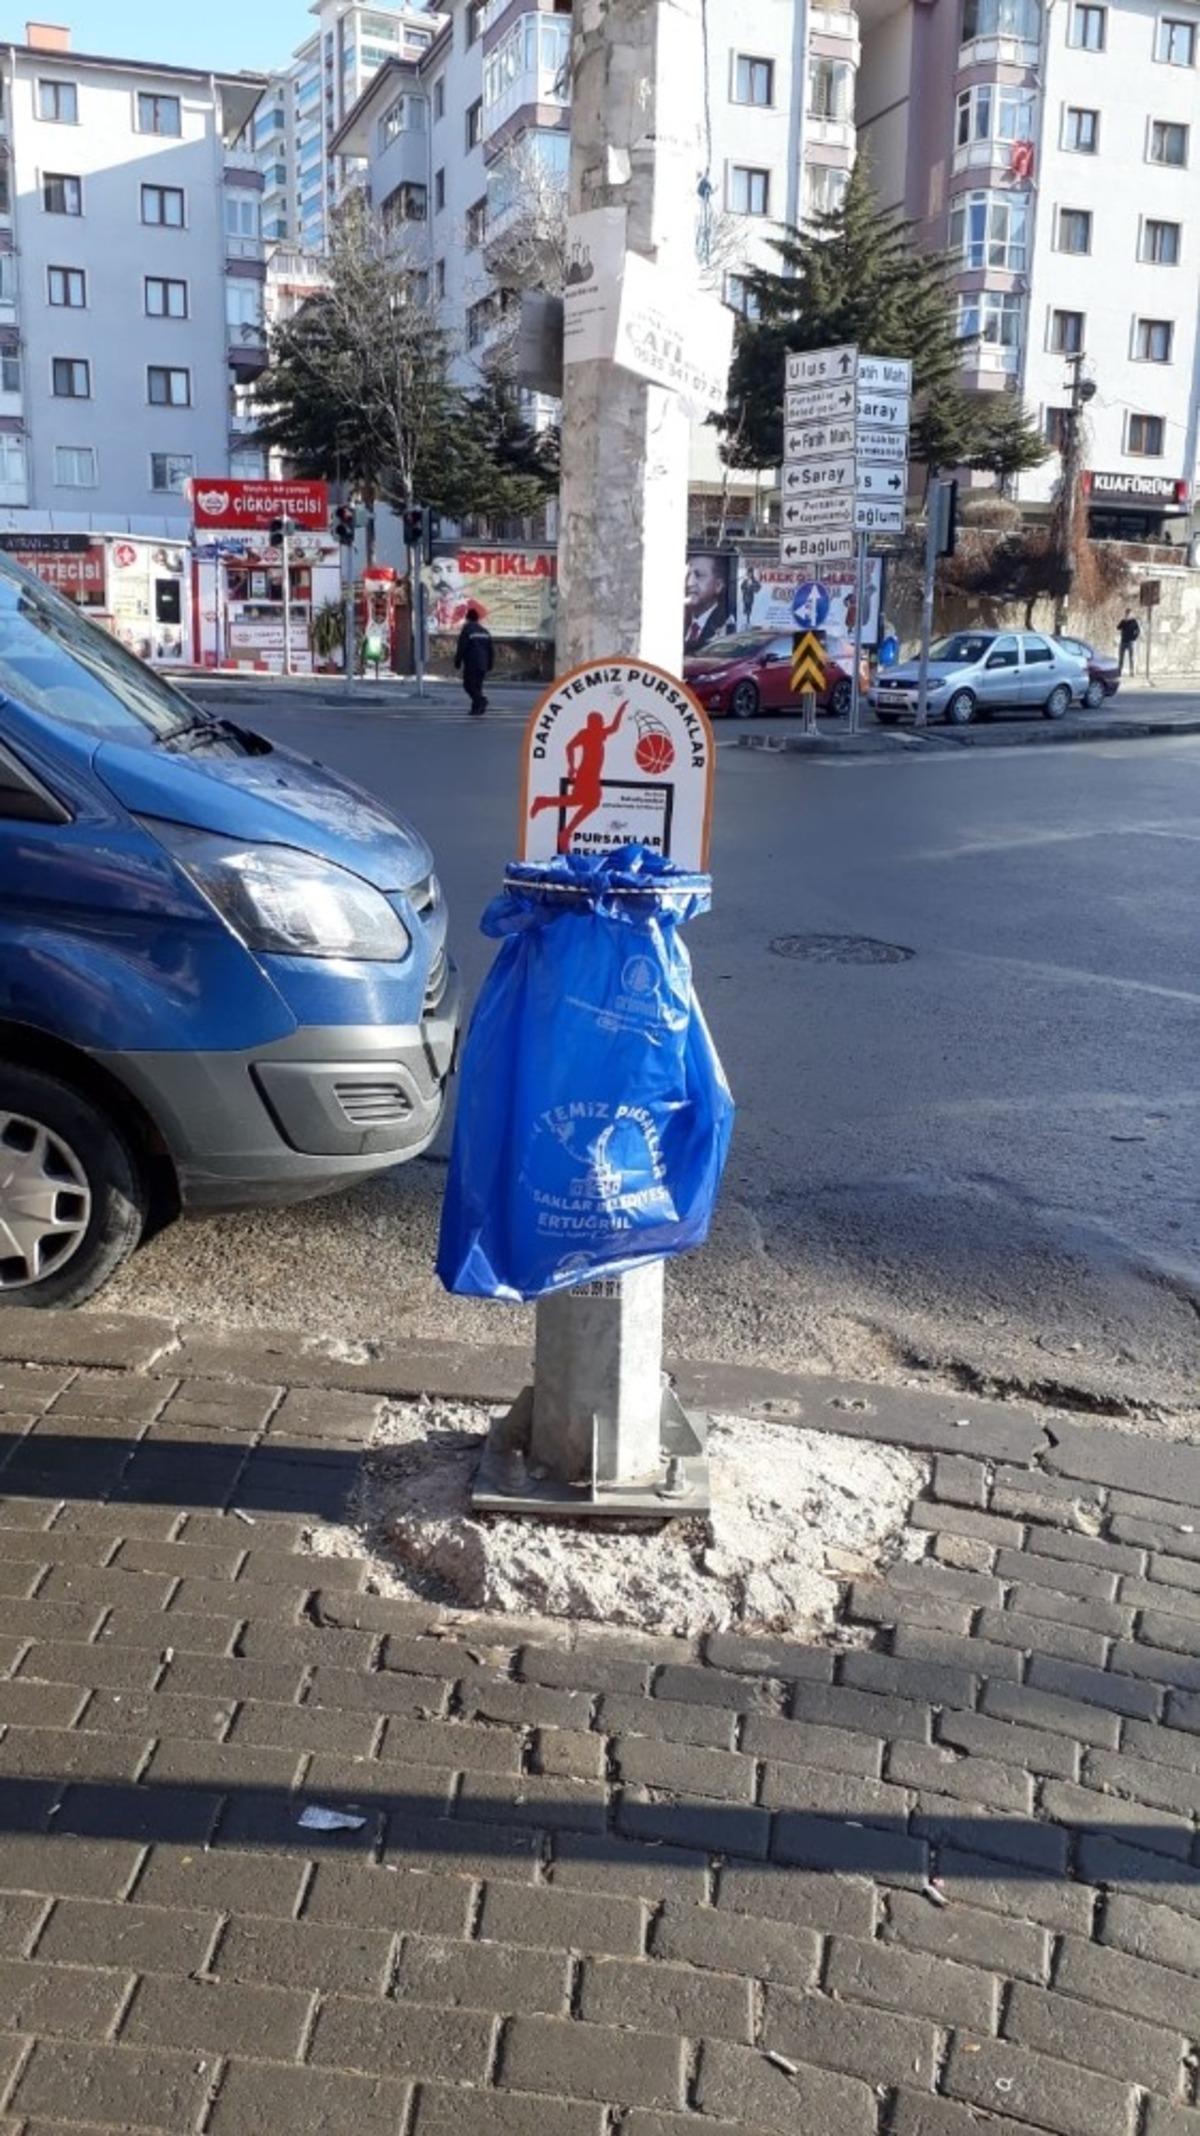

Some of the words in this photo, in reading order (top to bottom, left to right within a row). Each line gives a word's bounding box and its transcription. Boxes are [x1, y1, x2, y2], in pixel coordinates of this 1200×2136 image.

[789, 362, 826, 379] Ulus
[858, 365, 878, 380] atih
[801, 468, 845, 484] Saray
[857, 509, 900, 526] ağlum
[533, 703, 563, 760] DAHA
[627, 669, 705, 769] PURSAKLAR
[573, 832, 662, 847] PURSAKLAR
[532, 1188, 593, 1212] SAKLAR
